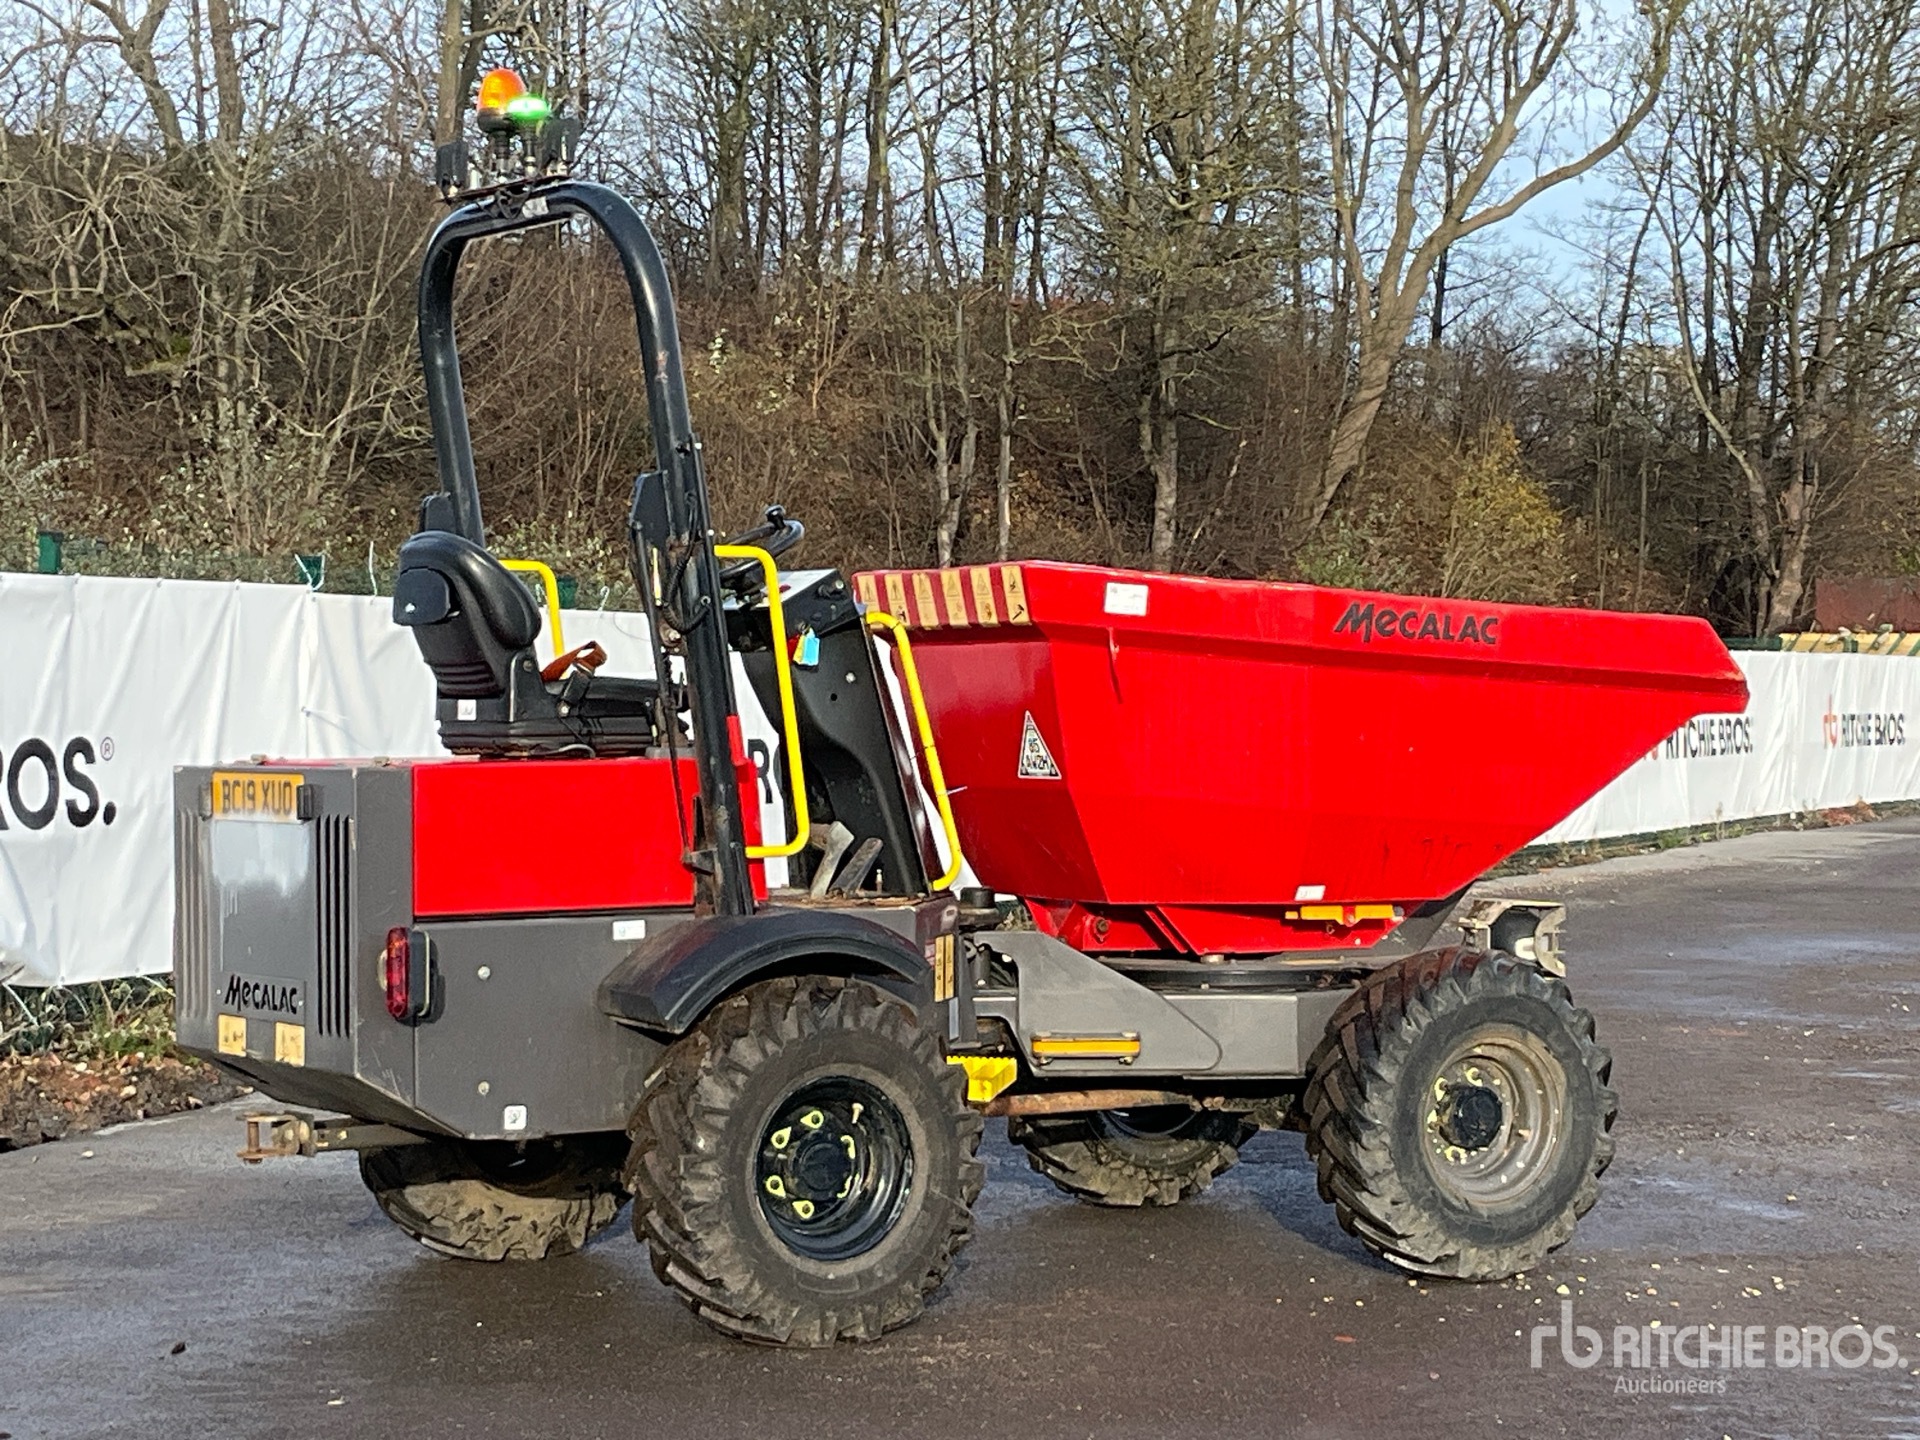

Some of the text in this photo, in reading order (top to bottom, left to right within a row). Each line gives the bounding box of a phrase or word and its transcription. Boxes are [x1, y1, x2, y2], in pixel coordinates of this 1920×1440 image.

[1719, 717, 1754, 755] BROS.
[0, 736, 117, 831] OS.
[222, 779, 256, 814] BC19
